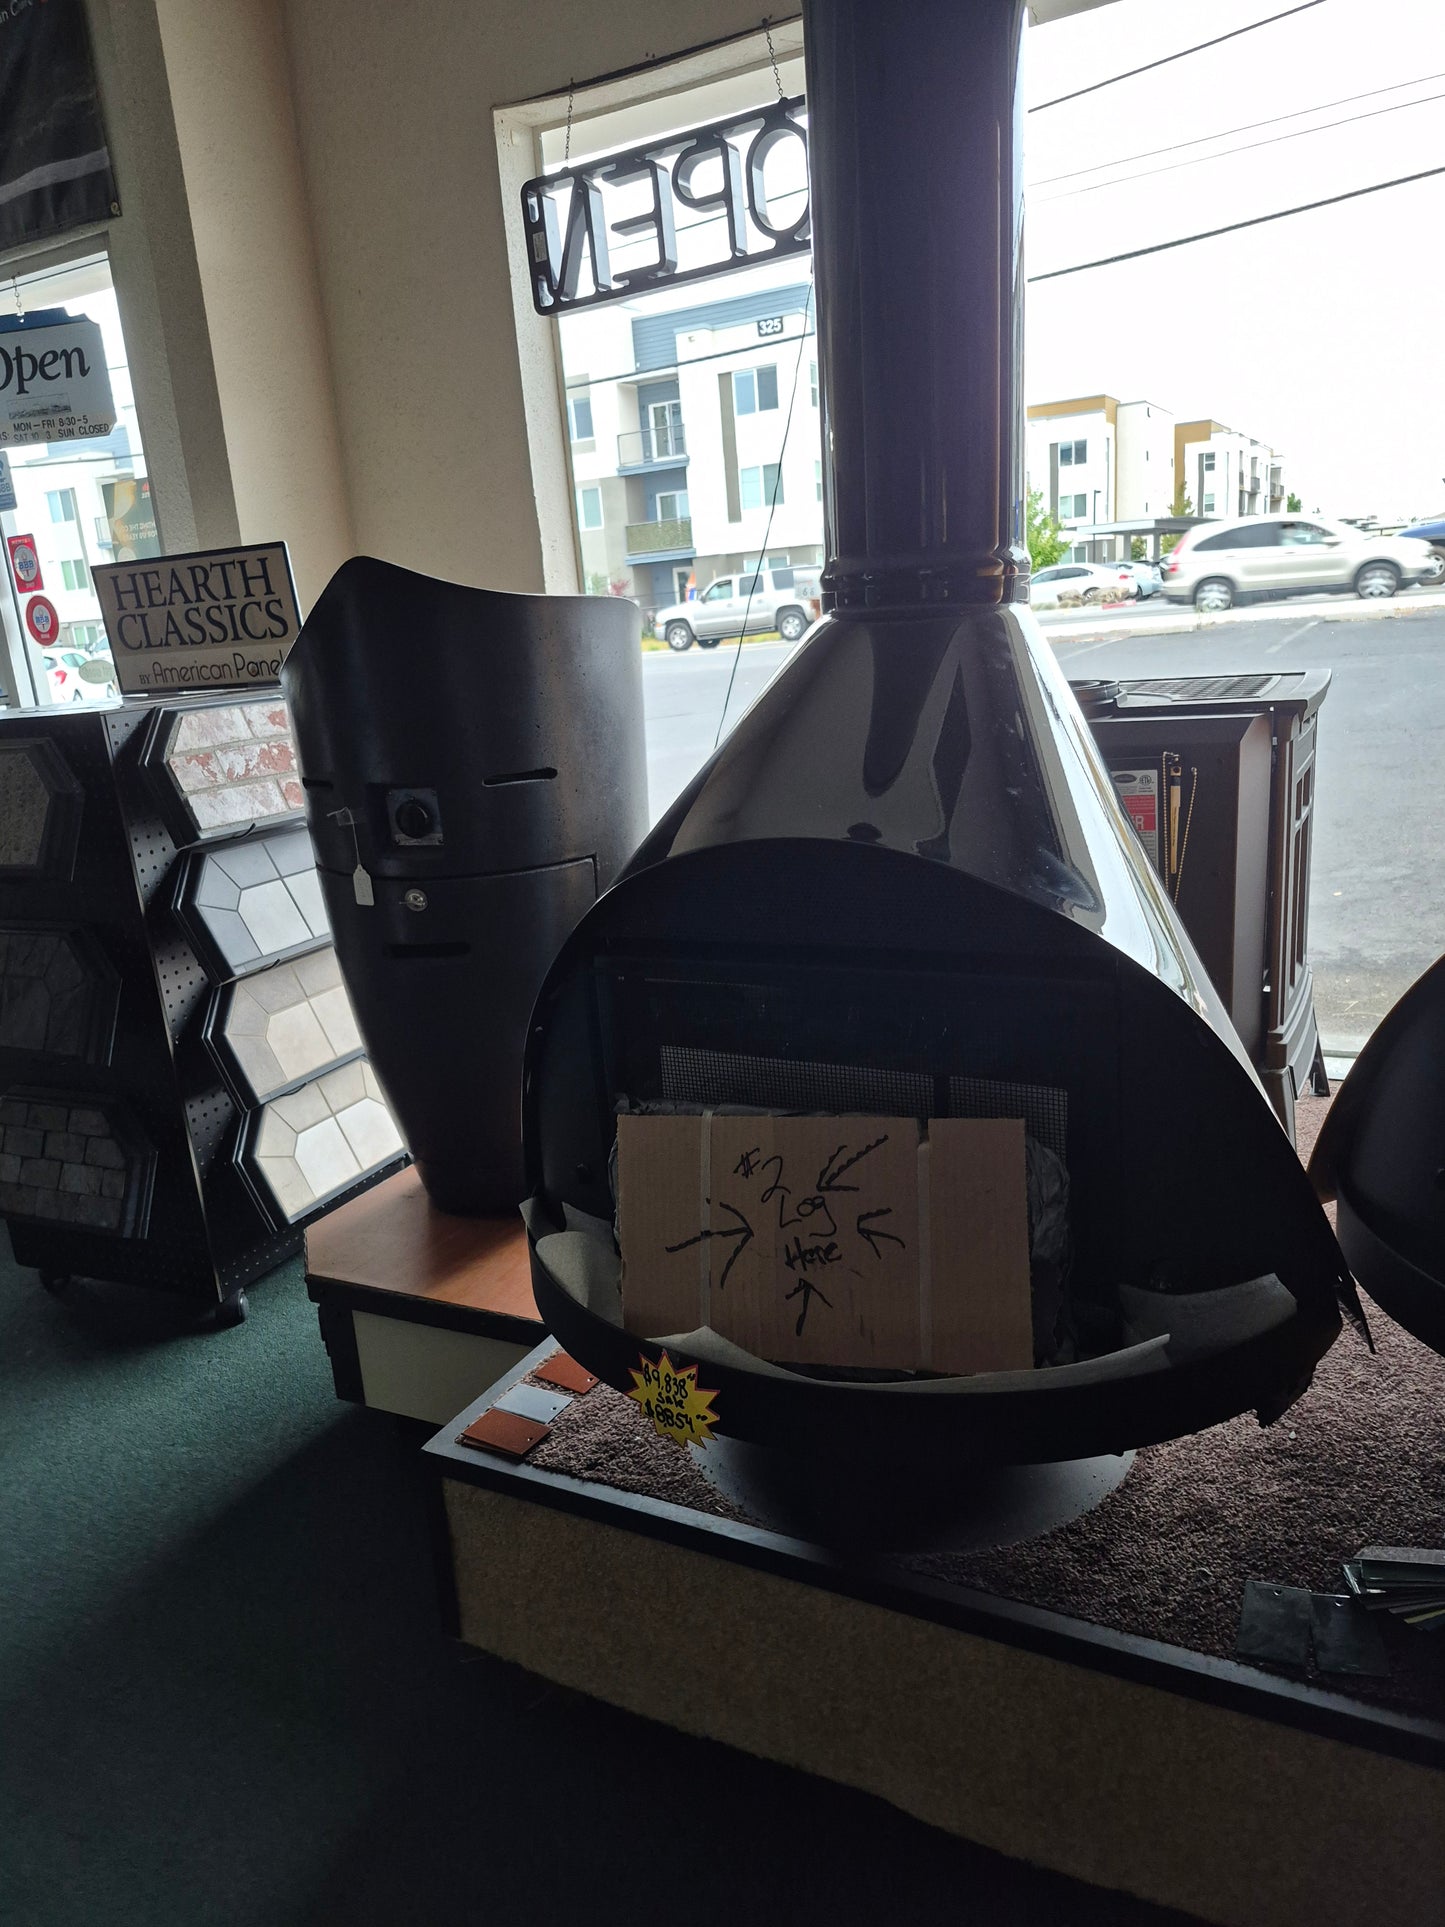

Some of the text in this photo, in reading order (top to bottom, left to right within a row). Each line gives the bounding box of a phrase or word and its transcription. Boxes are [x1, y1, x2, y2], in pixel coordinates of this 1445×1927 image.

[759, 319, 782, 334] 325
[58, 428, 75, 438] SUN
[78, 423, 110, 435] CLOSED
[18, 560, 34, 570] BBB
[110, 557, 275, 611] HEARTH
[117, 598, 289, 650] CLASSICS
[139, 674, 151, 685] BY
[152, 660, 234, 684] American
[780, 1194, 837, 1237] Log
[785, 1236, 842, 1271] Here
